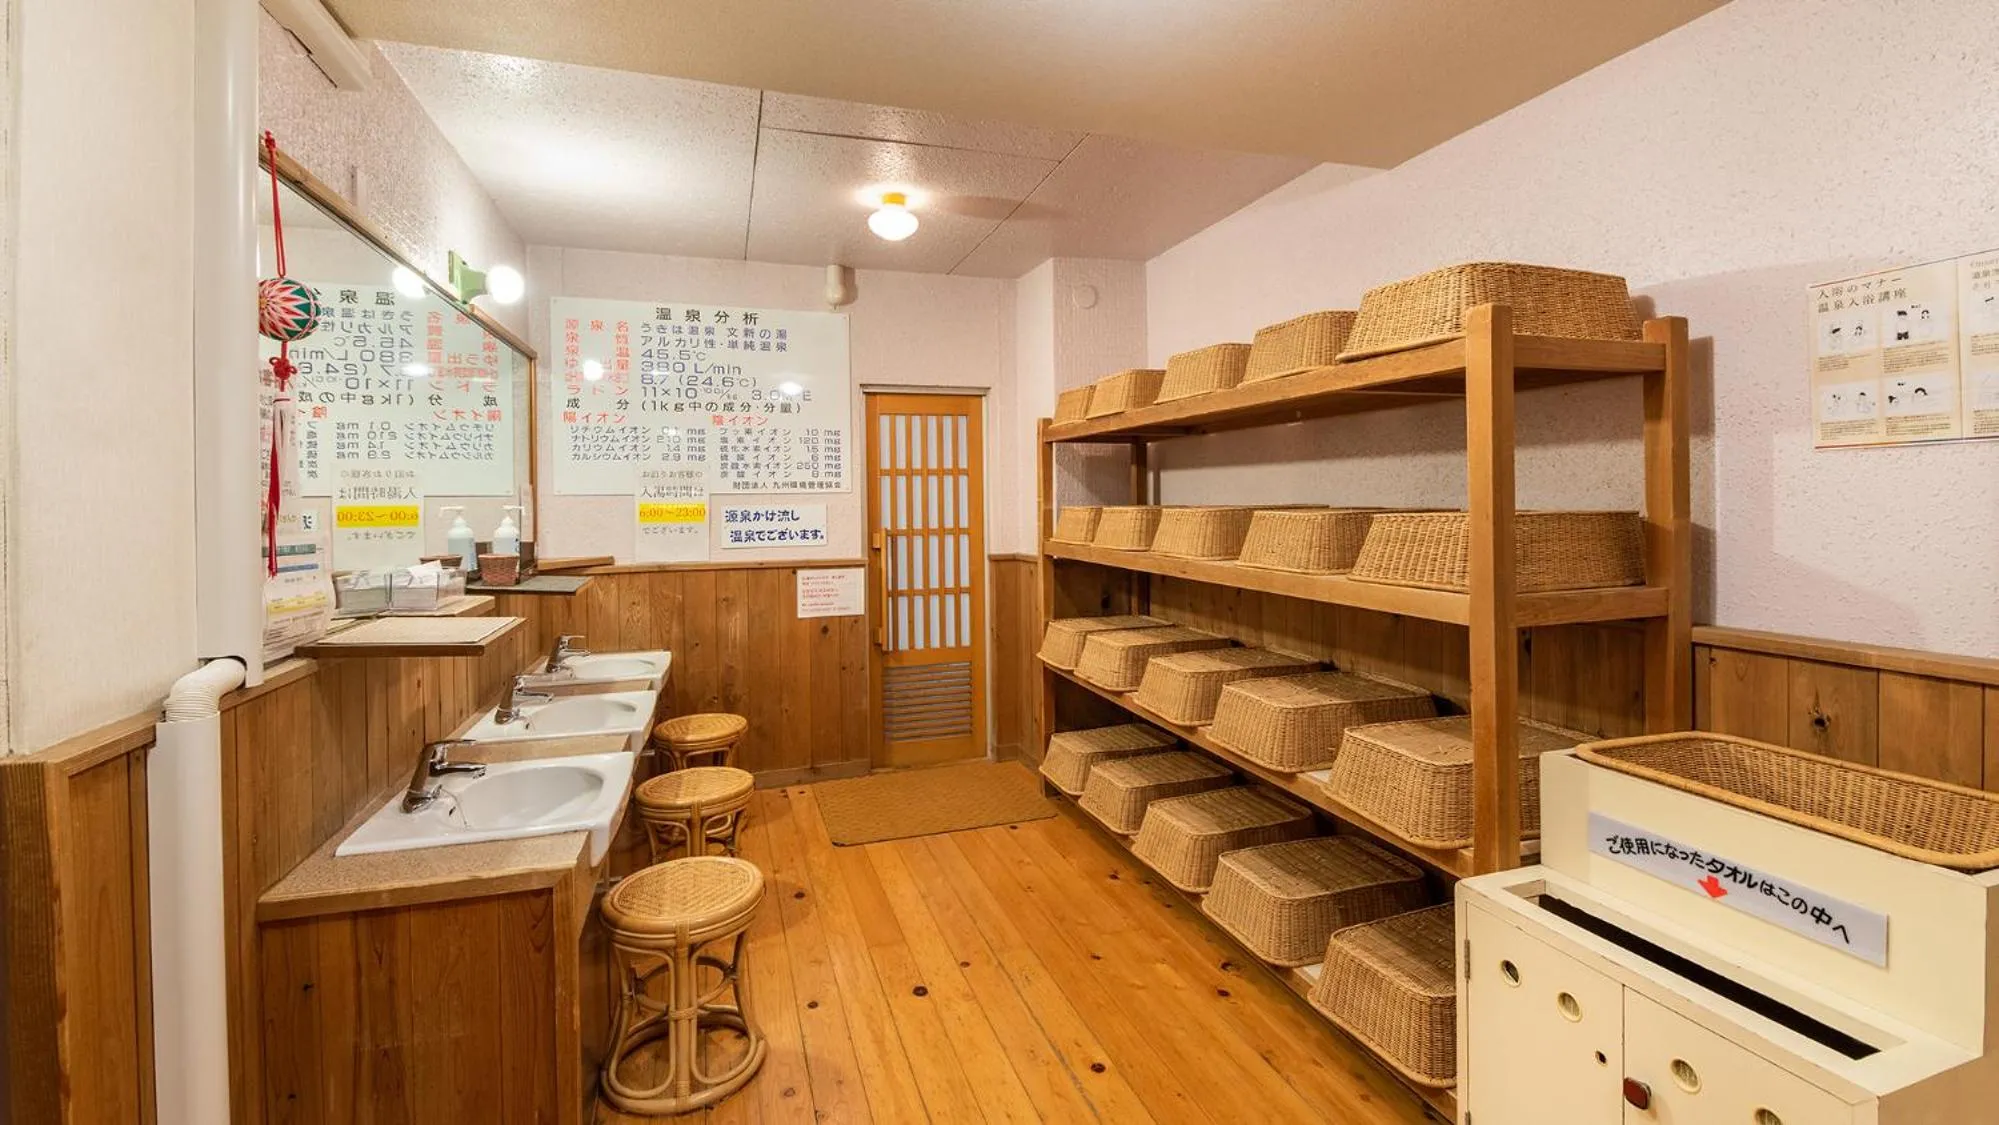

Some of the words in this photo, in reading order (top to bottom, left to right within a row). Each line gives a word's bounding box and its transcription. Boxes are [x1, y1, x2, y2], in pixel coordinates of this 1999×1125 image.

[655, 307, 760, 325] 温泉分析
[725, 509, 800, 523] 源泉かけ流し
[729, 527, 825, 543] 温泉でございます。
[1606, 834, 1851, 944] ご使用になったタオルはこの中へ
